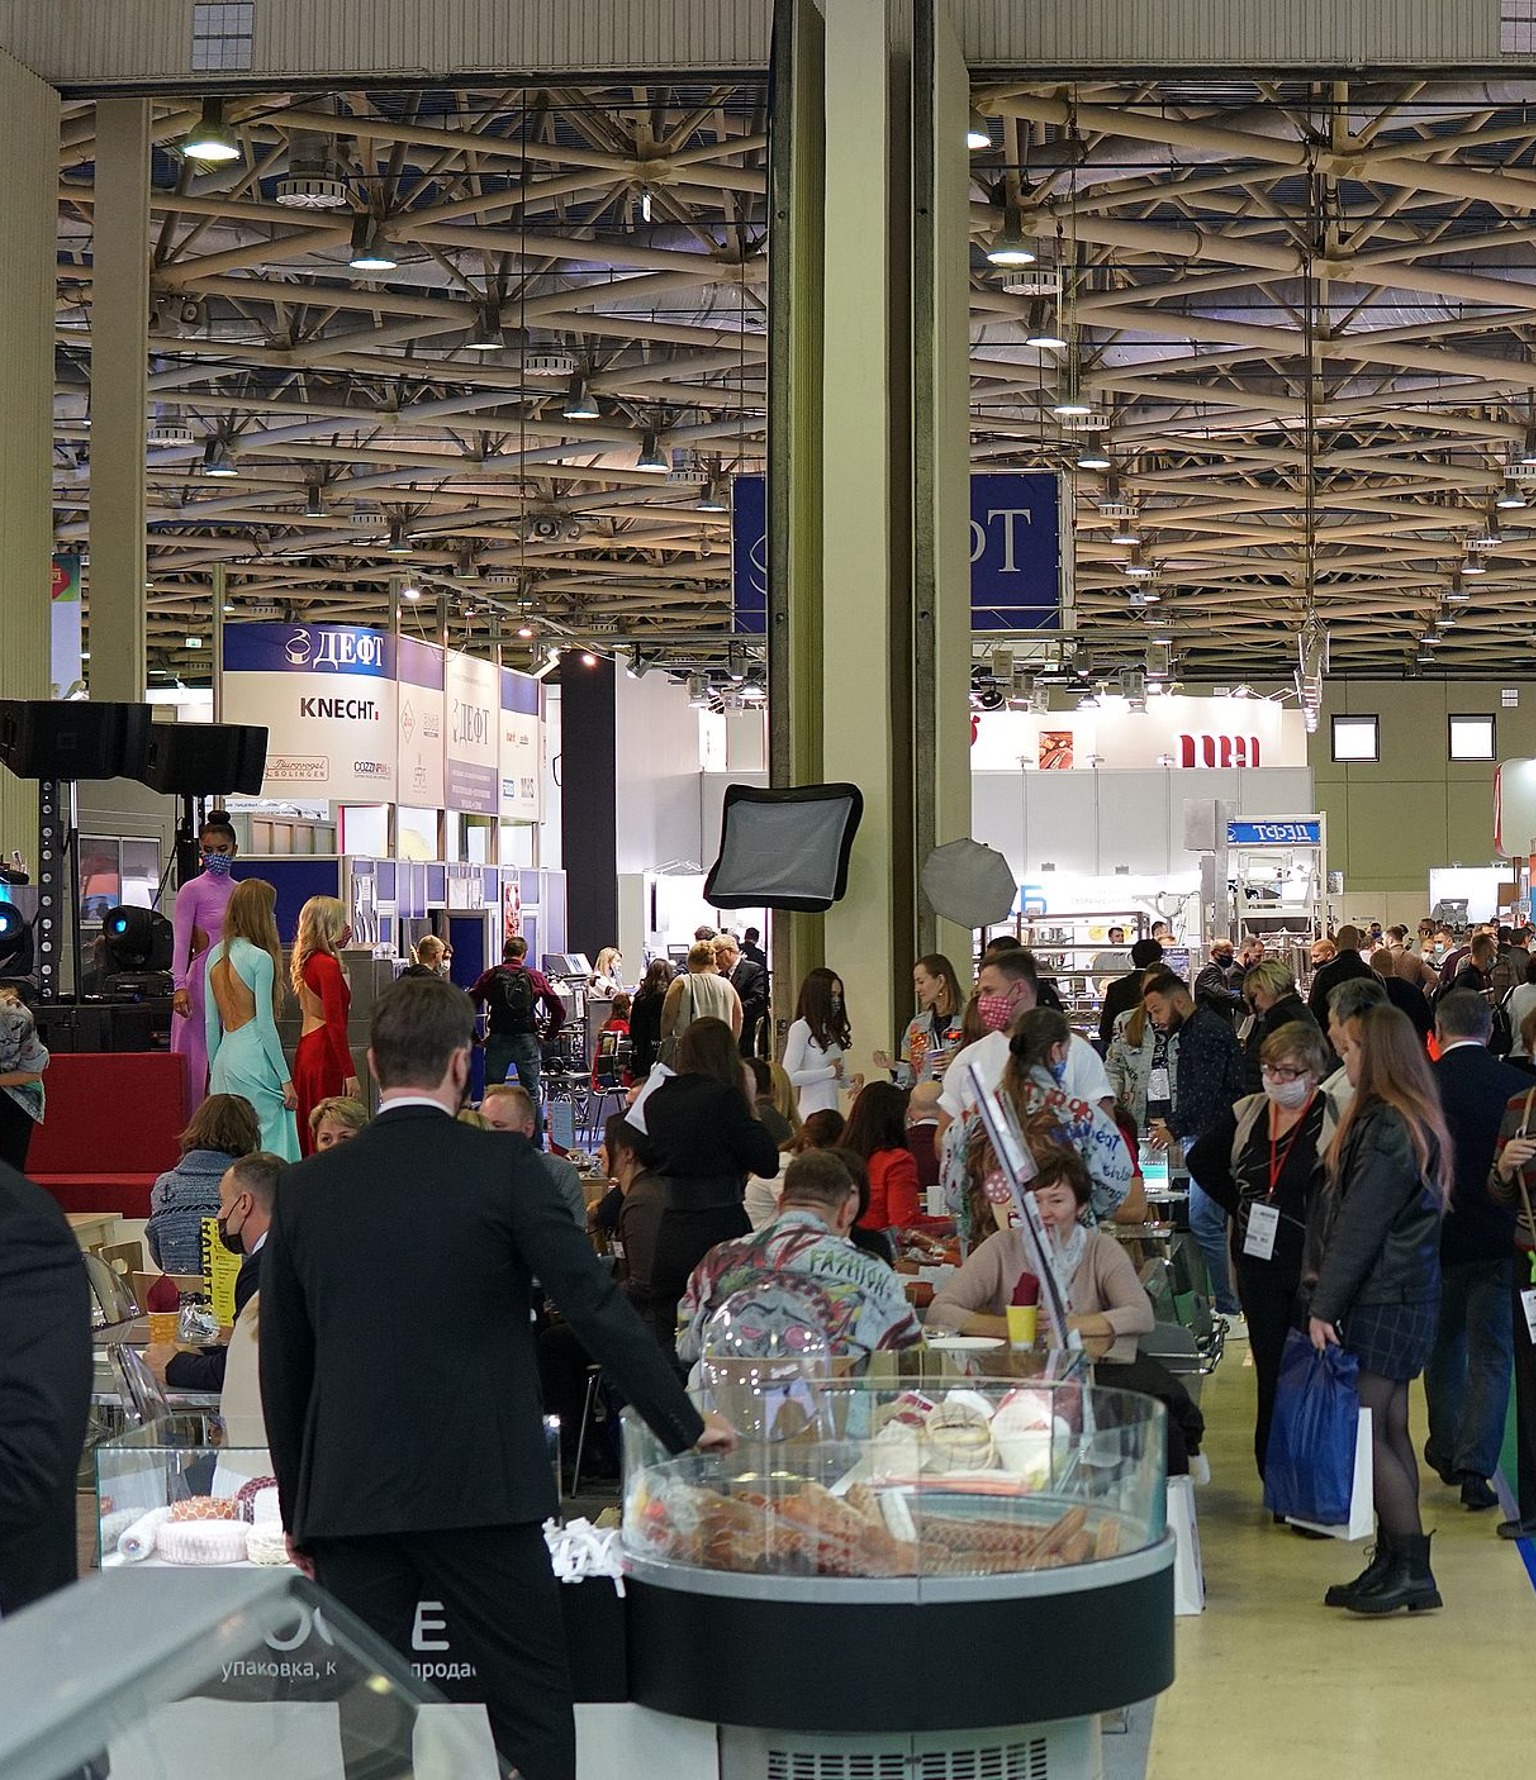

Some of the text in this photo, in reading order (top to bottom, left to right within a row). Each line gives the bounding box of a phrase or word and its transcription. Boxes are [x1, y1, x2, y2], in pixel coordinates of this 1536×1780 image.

[312, 631, 384, 670] ДЕФТ
[459, 702, 490, 747] ДЕФТ
[411, 1660, 477, 1682] прода
